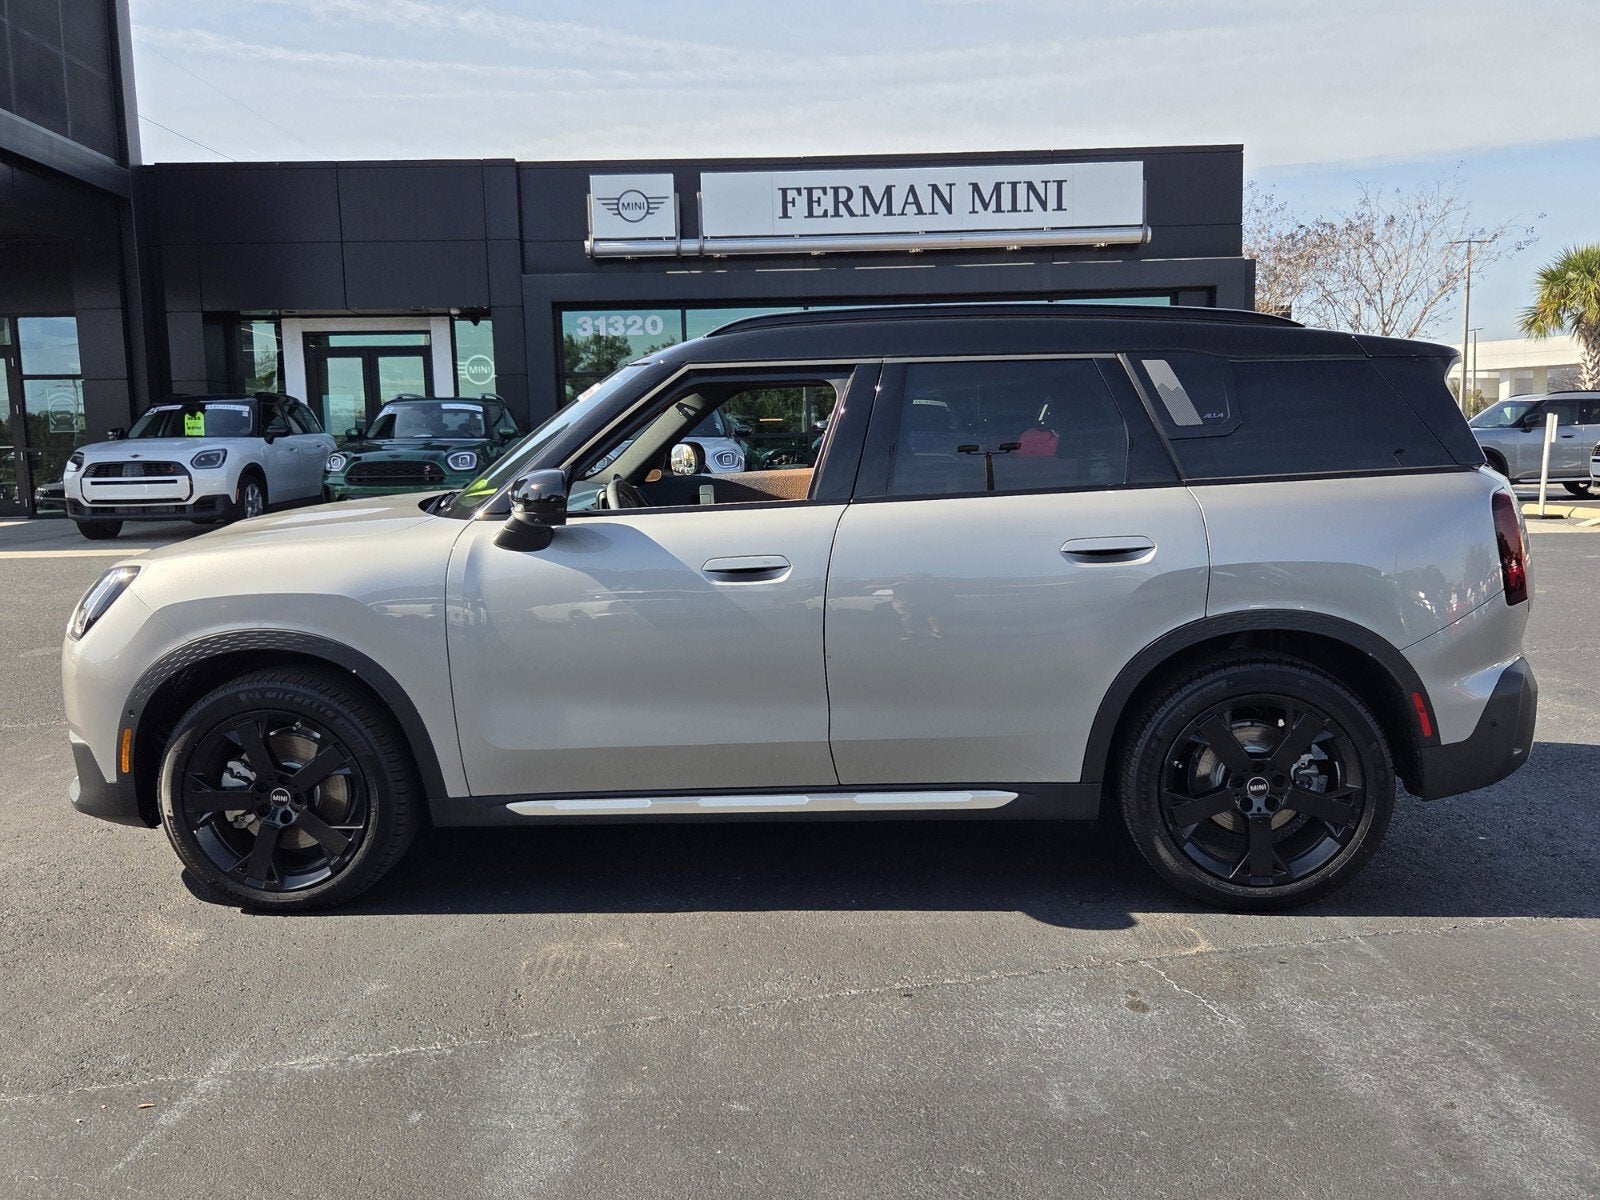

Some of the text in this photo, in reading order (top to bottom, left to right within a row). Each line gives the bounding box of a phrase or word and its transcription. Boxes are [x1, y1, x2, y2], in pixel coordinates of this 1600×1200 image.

[621, 202, 646, 210] MINI
[778, 179, 1068, 219] FERMAN MINI
[576, 315, 664, 337] 31320
[469, 365, 491, 374] MINI
